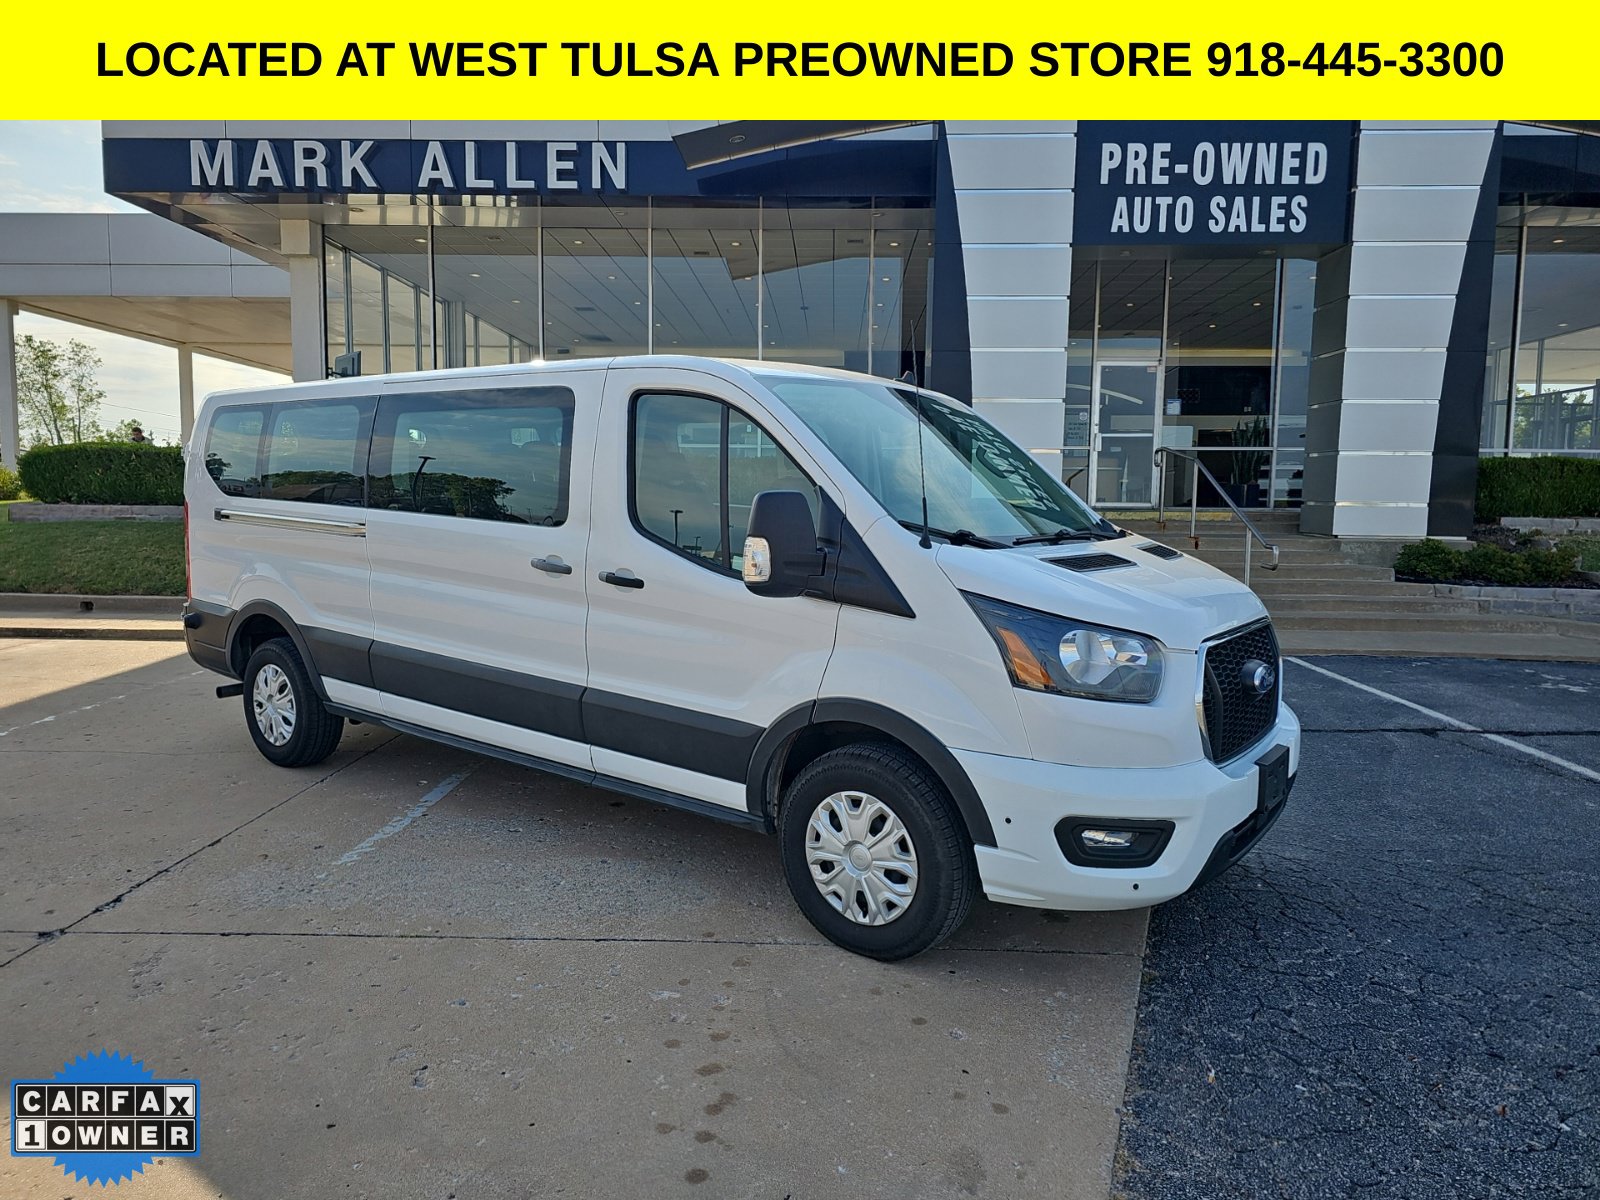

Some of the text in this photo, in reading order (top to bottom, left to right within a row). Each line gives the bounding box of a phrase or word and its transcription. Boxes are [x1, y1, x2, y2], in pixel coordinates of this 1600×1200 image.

[189, 139, 628, 190] MARK ALLEN
[1100, 141, 1328, 185] PRE-OWNED
[1110, 194, 1309, 234] AUTO SALES
